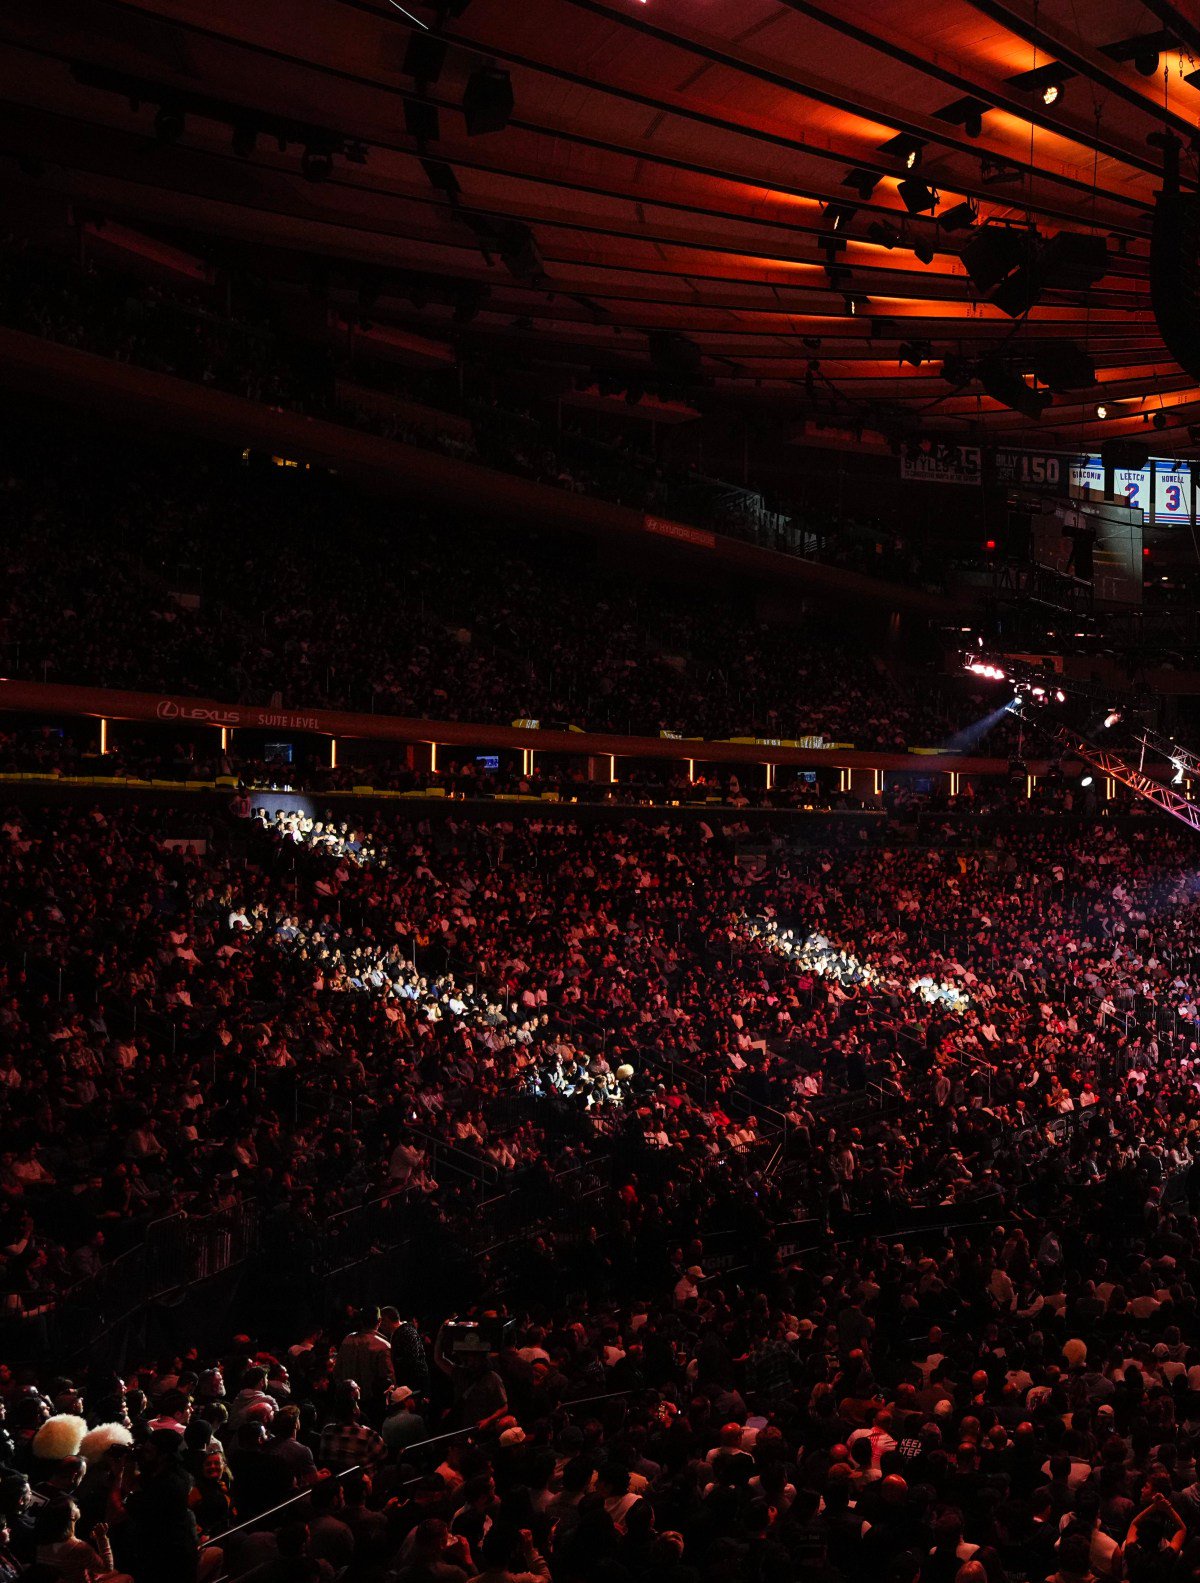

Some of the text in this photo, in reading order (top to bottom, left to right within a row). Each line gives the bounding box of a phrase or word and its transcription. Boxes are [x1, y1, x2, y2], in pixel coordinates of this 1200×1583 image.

[1020, 455, 1060, 484] 150
[1119, 473, 1145, 482] LEETCH
[1161, 475, 1185, 484] HOWELL
[1124, 483, 1140, 509] 2
[1165, 485, 1181, 511] 3
[181, 708, 320, 730] LEXUS SUITE LEVEL
